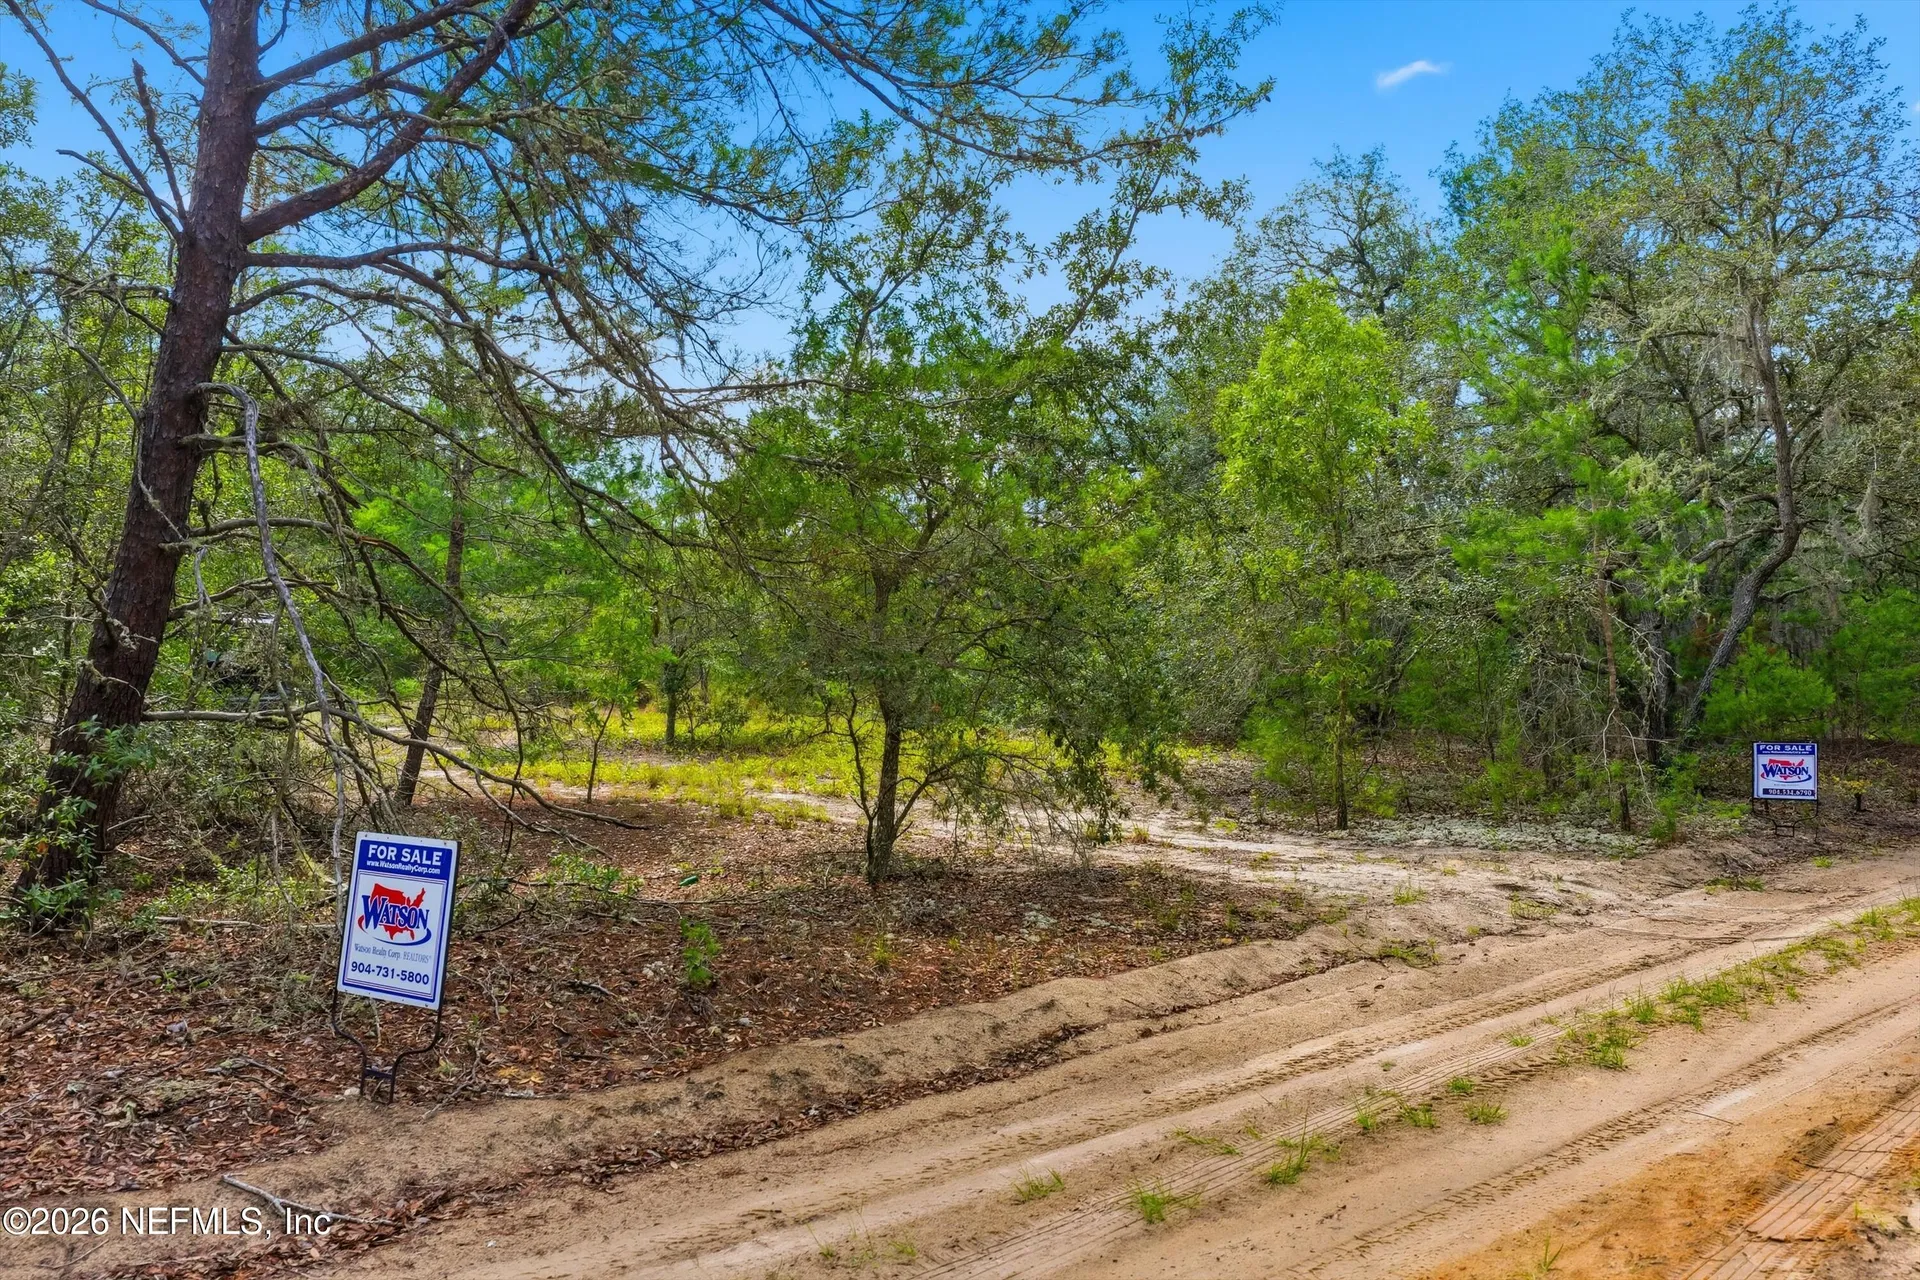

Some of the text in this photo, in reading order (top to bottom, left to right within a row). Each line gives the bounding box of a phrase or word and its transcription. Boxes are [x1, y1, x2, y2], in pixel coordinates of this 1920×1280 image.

[1761, 764, 1809, 778] WATSON
[368, 844, 443, 866] FOR SALE
[366, 860, 441, 874] www.WatsonRealtyCorp.com
[361, 894, 430, 931] WATSON
[354, 943, 371, 954] Watson
[351, 961, 430, 985] 904-731-5800
